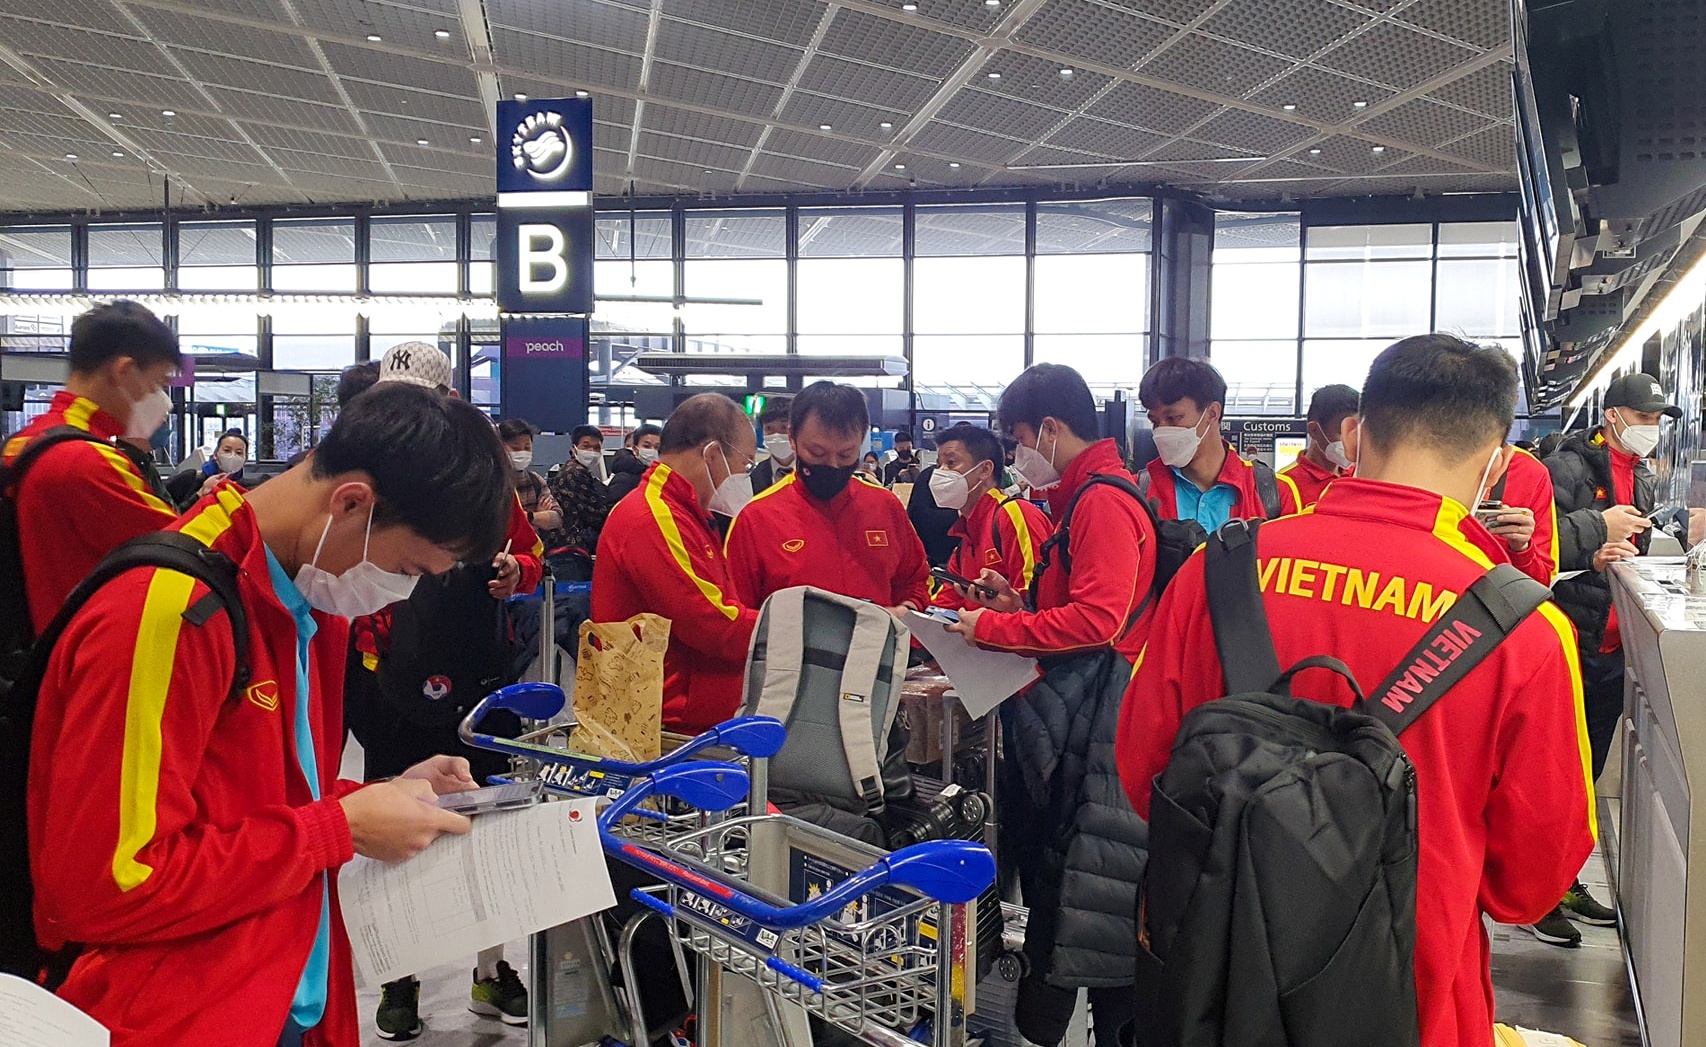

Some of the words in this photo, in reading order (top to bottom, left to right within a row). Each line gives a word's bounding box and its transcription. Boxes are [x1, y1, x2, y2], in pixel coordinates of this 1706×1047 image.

[518, 223, 568, 293] B
[390, 349, 411, 371] NY
[525, 340, 564, 354] peach
[1243, 422, 1291, 431] Customs
[1256, 557, 1458, 623] VIETNAM
[1381, 620, 1482, 714] VIETNAM
